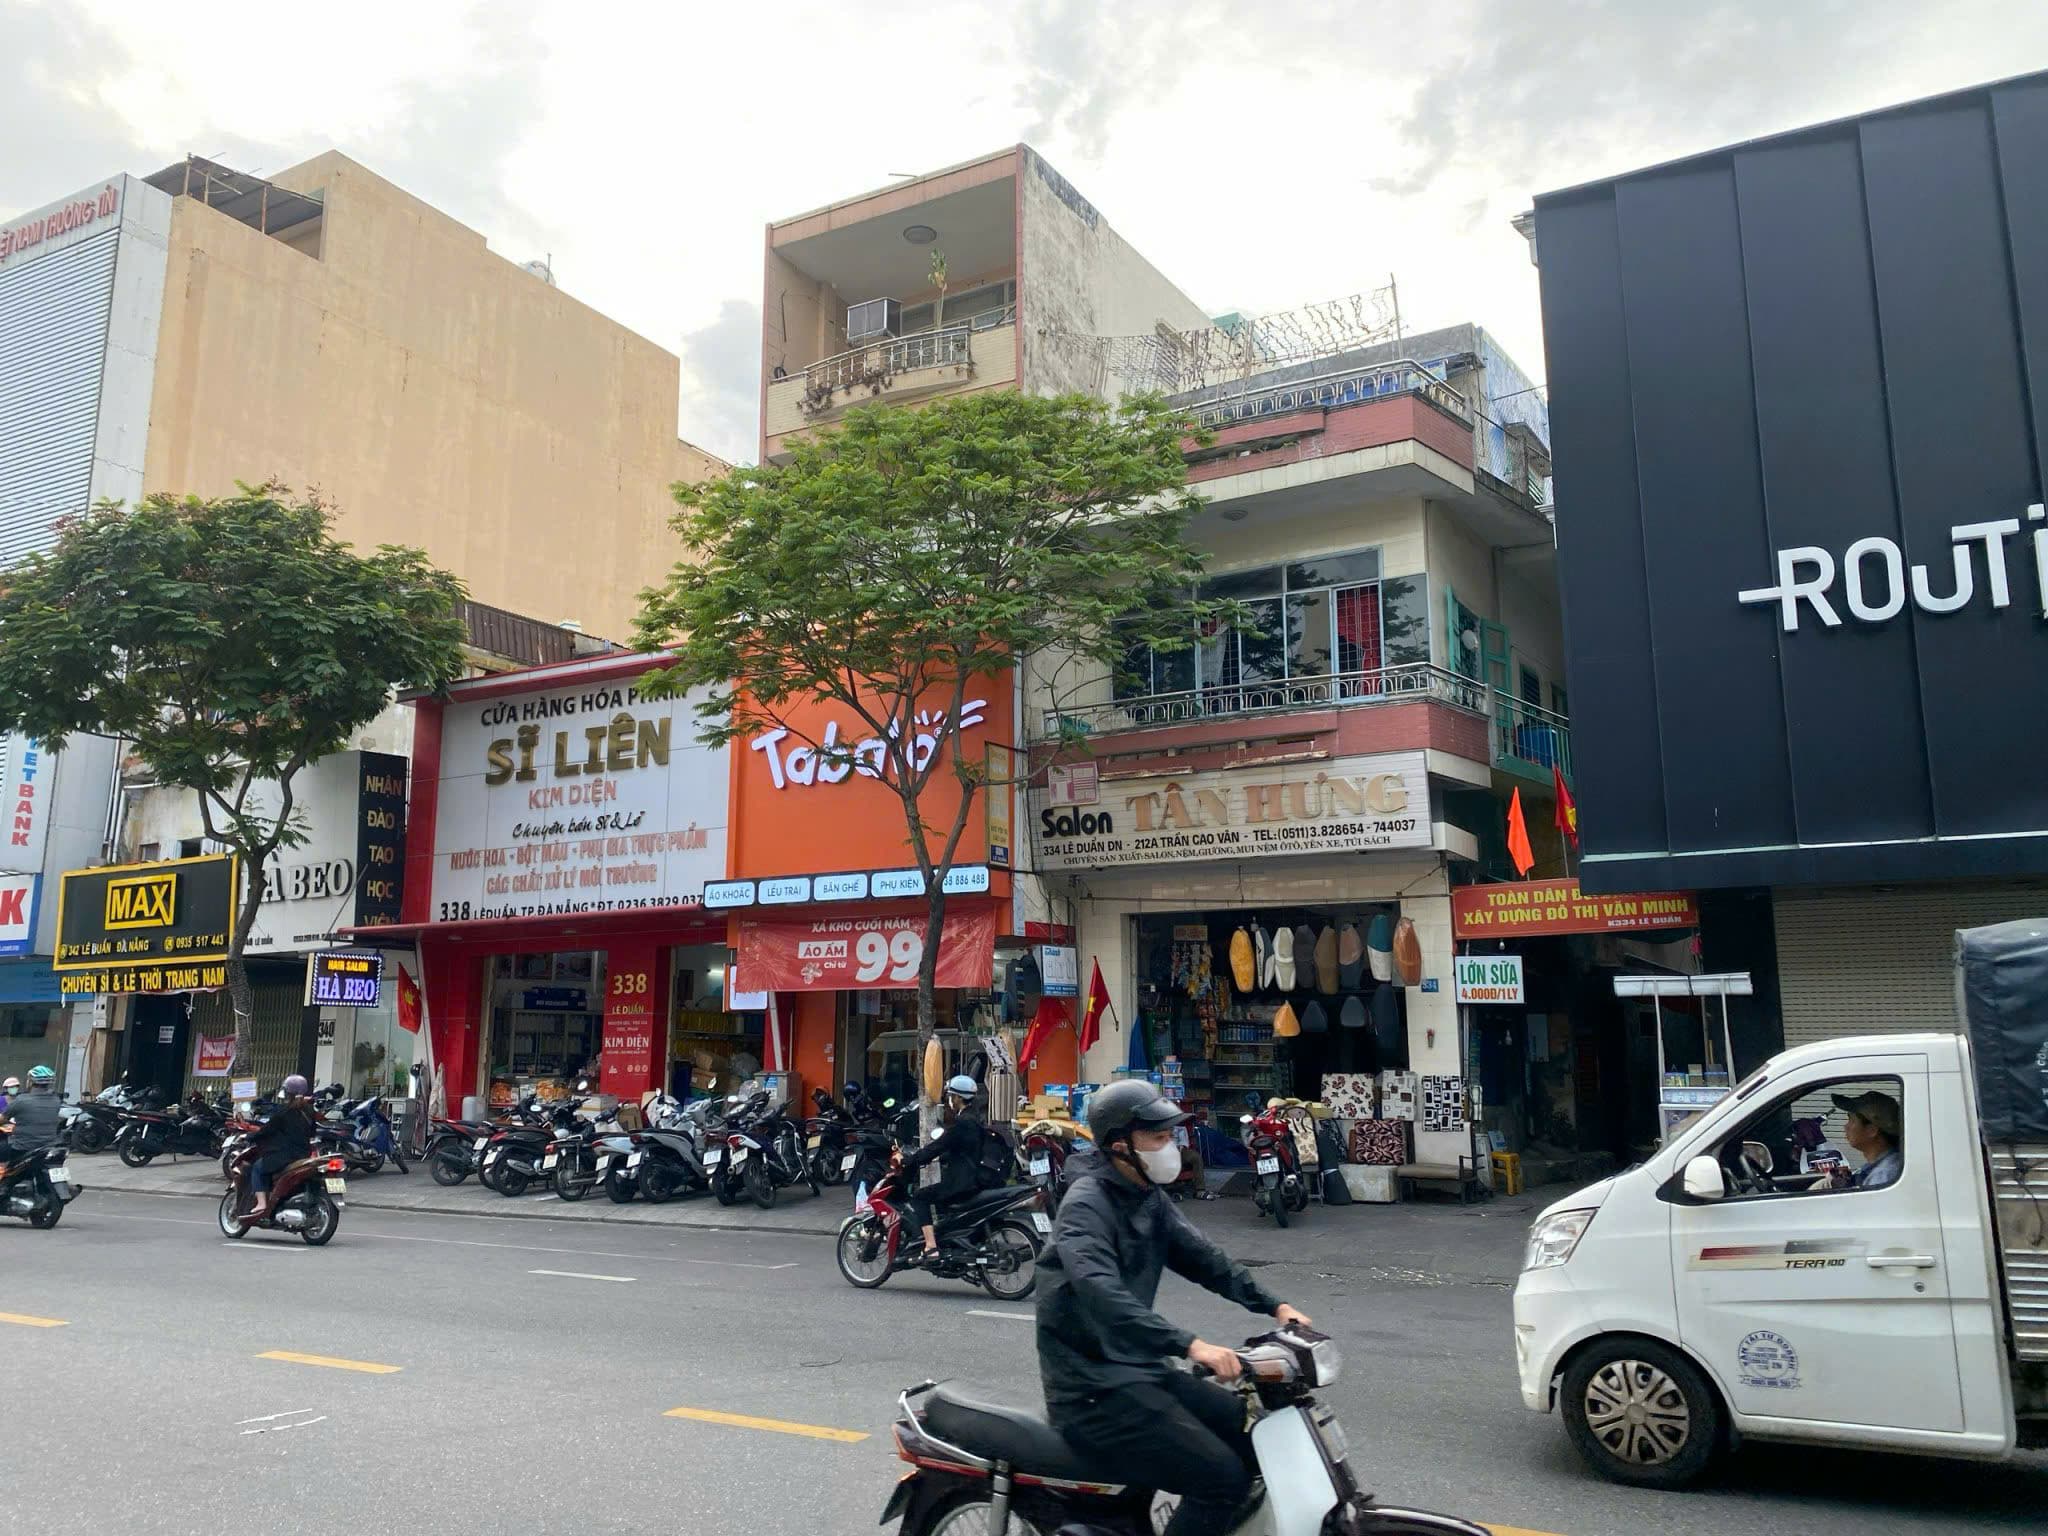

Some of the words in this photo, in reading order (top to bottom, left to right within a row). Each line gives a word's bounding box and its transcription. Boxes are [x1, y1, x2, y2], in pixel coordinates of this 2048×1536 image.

[15, 219, 45, 252] NAM
[481, 700, 518, 727] CỬA
[522, 694, 576, 721] HÀNG
[581, 686, 623, 713] HÓA
[554, 712, 672, 778] LIÊN
[366, 774, 402, 798] NHẬN
[528, 787, 563, 810] KIM
[568, 777, 617, 808] DIỆN
[1125, 781, 1232, 832] TÂN
[1243, 772, 1410, 825] HƯNG
[367, 807, 395, 829] ĐÀO
[568, 815, 593, 834] bán
[1041, 806, 1113, 839] Salon
[1043, 845, 1061, 857] 334
[1062, 842, 1075, 855] LÊ
[1076, 837, 1106, 853] DUẨN
[1134, 837, 1158, 850] 212A
[1193, 834, 1215, 846] CAO
[1217, 829, 1240, 844] VÂN
[1373, 819, 1417, 833] 744037
[1063, 854, 1099, 866] CHUYÊN
[1364, 829, 1391, 845] SÁCH
[369, 845, 394, 867] TẠO
[484, 848, 507, 867] HOA
[286, 858, 353, 901] BEO
[367, 880, 394, 902] HỌC
[486, 872, 510, 895] CÁC
[111, 884, 170, 925] MAX
[1487, 889, 1529, 907] TOÀN
[1534, 888, 1567, 904] DÂN
[440, 902, 471, 922] 338
[1464, 907, 1493, 925] XÂY
[1499, 908, 1542, 926] DỰNG
[1546, 904, 1568, 921] ĐÔ
[1572, 905, 1599, 921] THỊ
[1602, 901, 1638, 917] VĂN
[1642, 898, 1689, 914] MINH
[812, 919, 827, 933] XẢ
[828, 920, 852, 933] KHO
[81, 941, 91, 955] LÊ
[176, 936, 193, 949] 0935
[196, 934, 209, 947] 517
[211, 933, 224, 946] 443
[803, 942, 822, 958] ÁO
[824, 941, 845, 957] ẤM
[345, 960, 369, 973] SALON
[855, 930, 924, 983] 99
[61, 972, 97, 994] CHUYÊN
[112, 973, 120, 992] &
[165, 968, 199, 989] TRANG
[203, 966, 225, 987] NAM
[612, 973, 648, 995] 338
[1490, 960, 1518, 985] SỮA
[317, 973, 341, 1000] HÀ
[343, 978, 377, 1001] BEO
[318, 1021, 335, 1038] 340
[604, 1037, 624, 1048] KIM
[626, 1033, 650, 1052] DIỆN
[1785, 1259, 1825, 1269] TERA
[1826, 1257, 1846, 1268] 100
